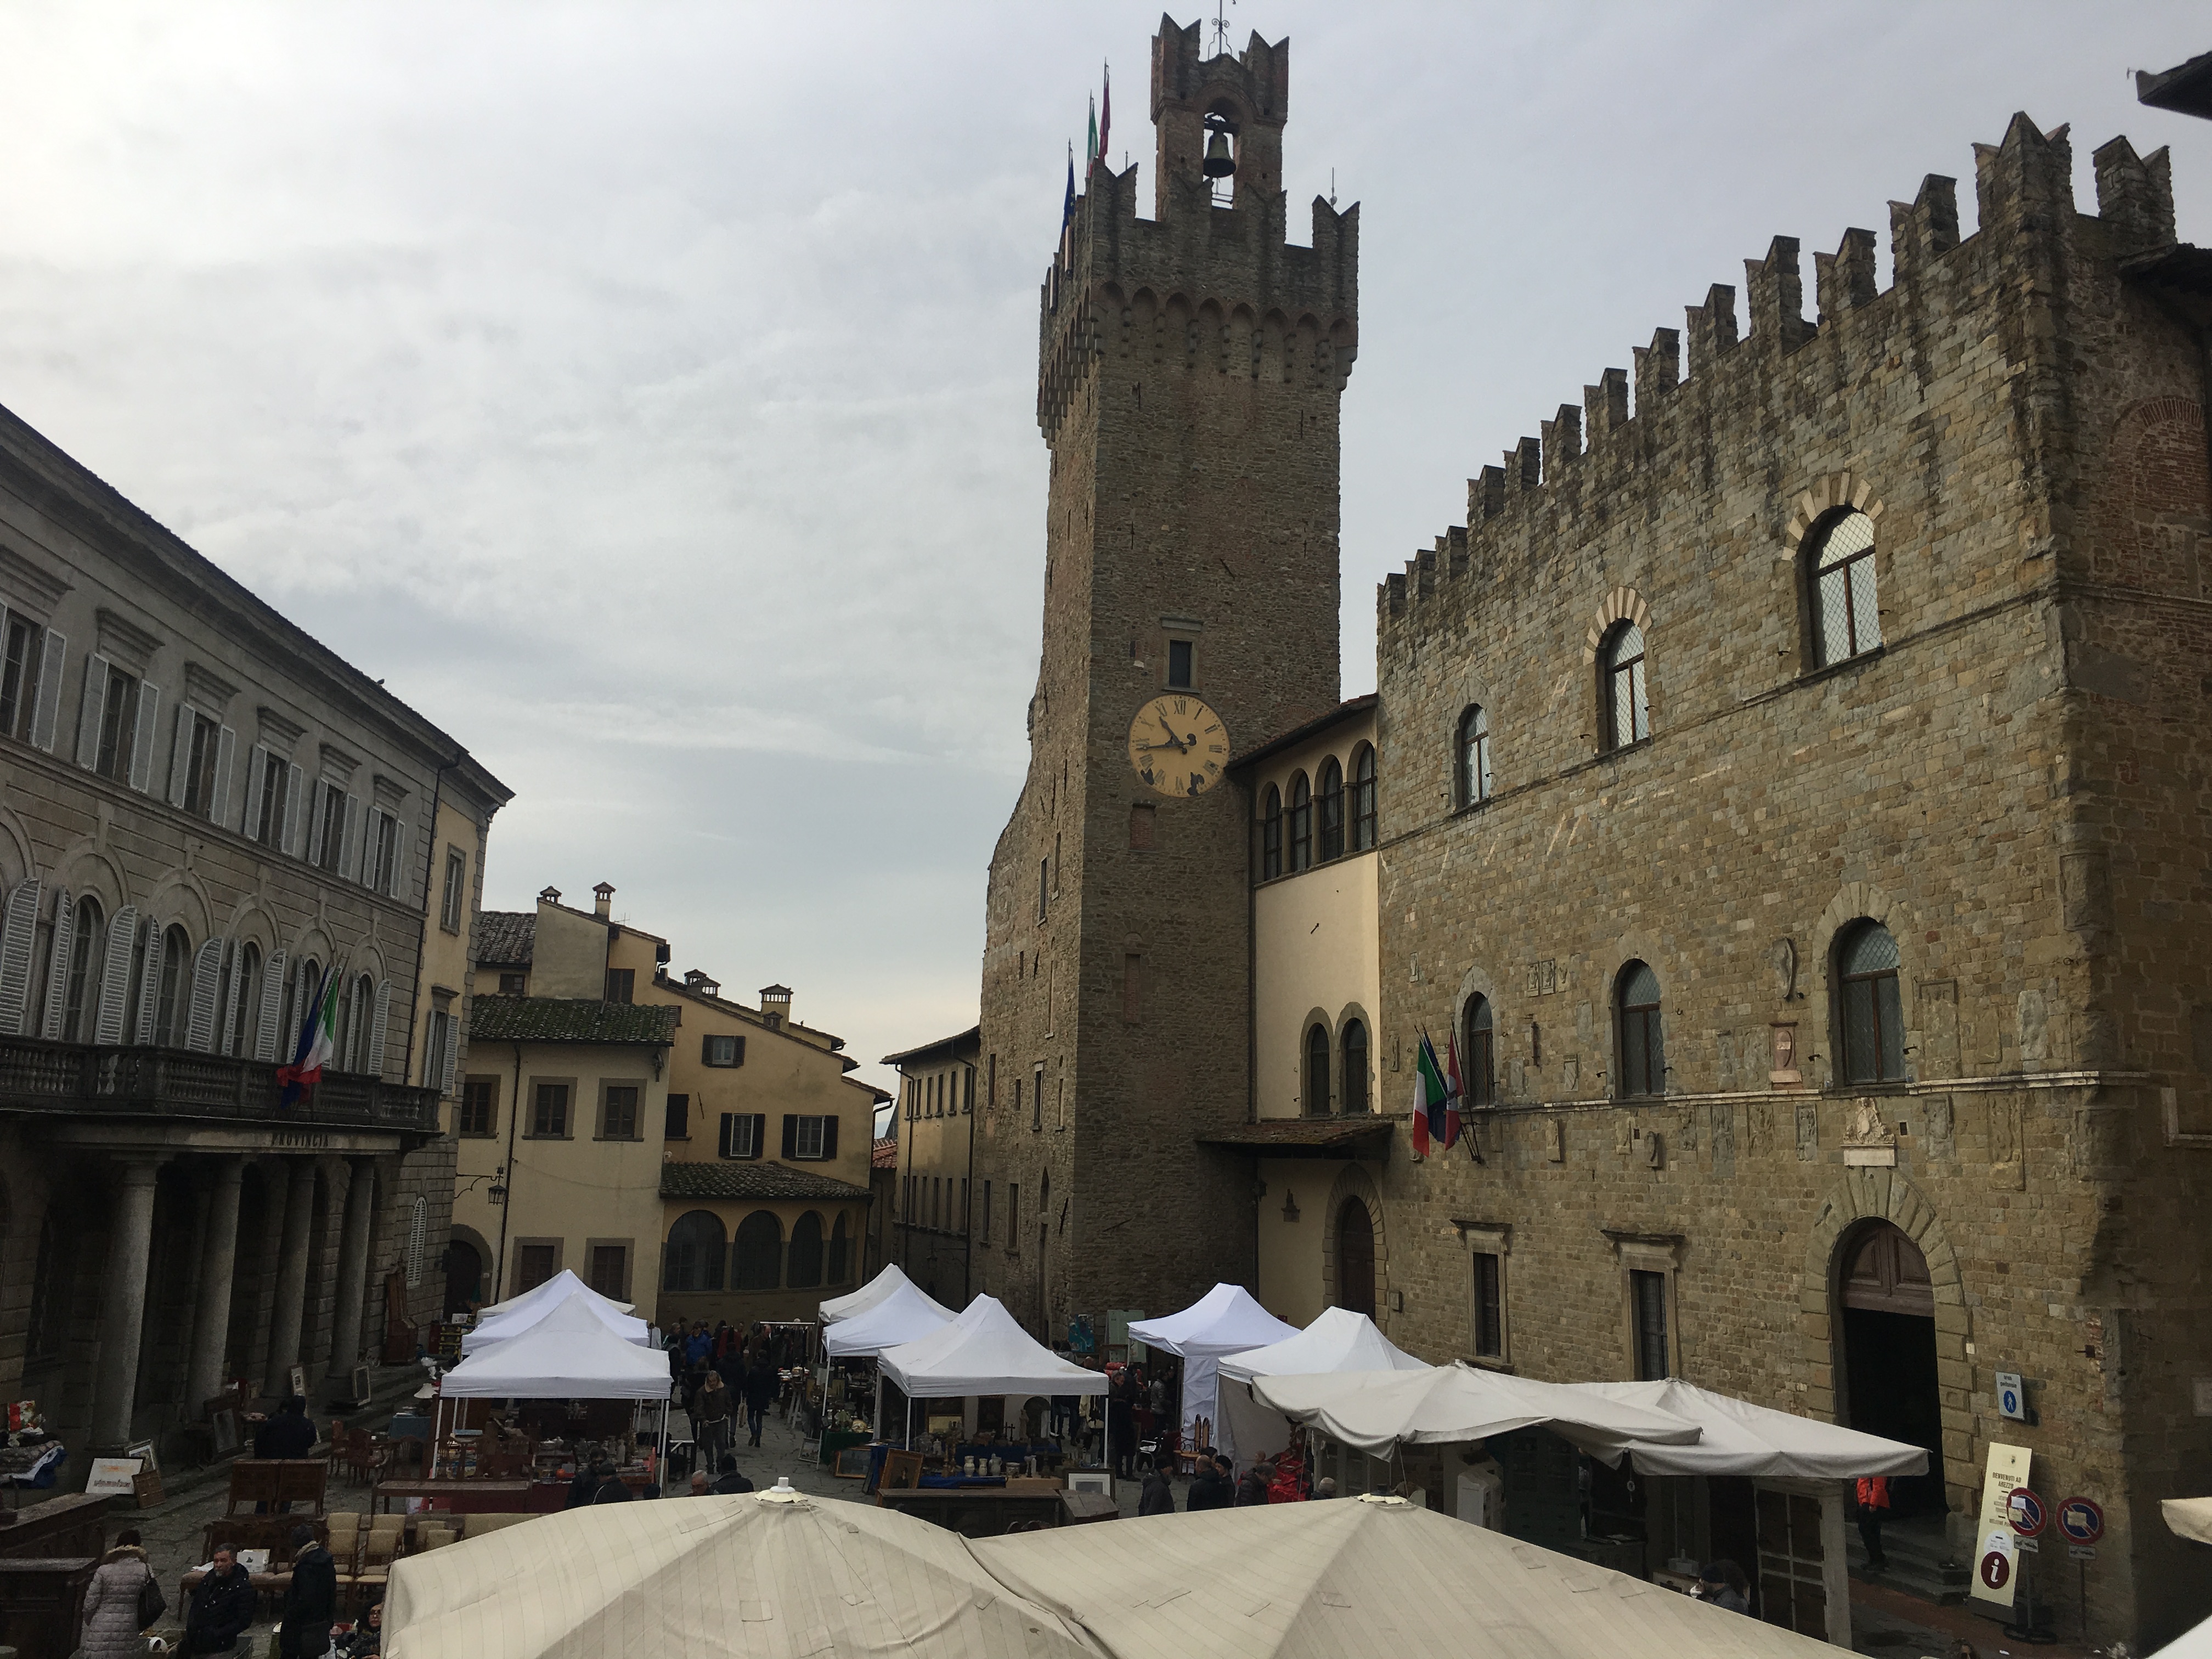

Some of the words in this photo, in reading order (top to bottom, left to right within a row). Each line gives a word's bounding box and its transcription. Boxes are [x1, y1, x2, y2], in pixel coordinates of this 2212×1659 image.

[1155, 702, 1167, 716] XI
[1173, 699, 1187, 715] XII
[1141, 718, 1155, 731] X
[271, 1132, 329, 1147] PROVINCIA
[1992, 1472, 2015, 1482] BENVENUTI
[1997, 1481, 2014, 1489] AREZZO
